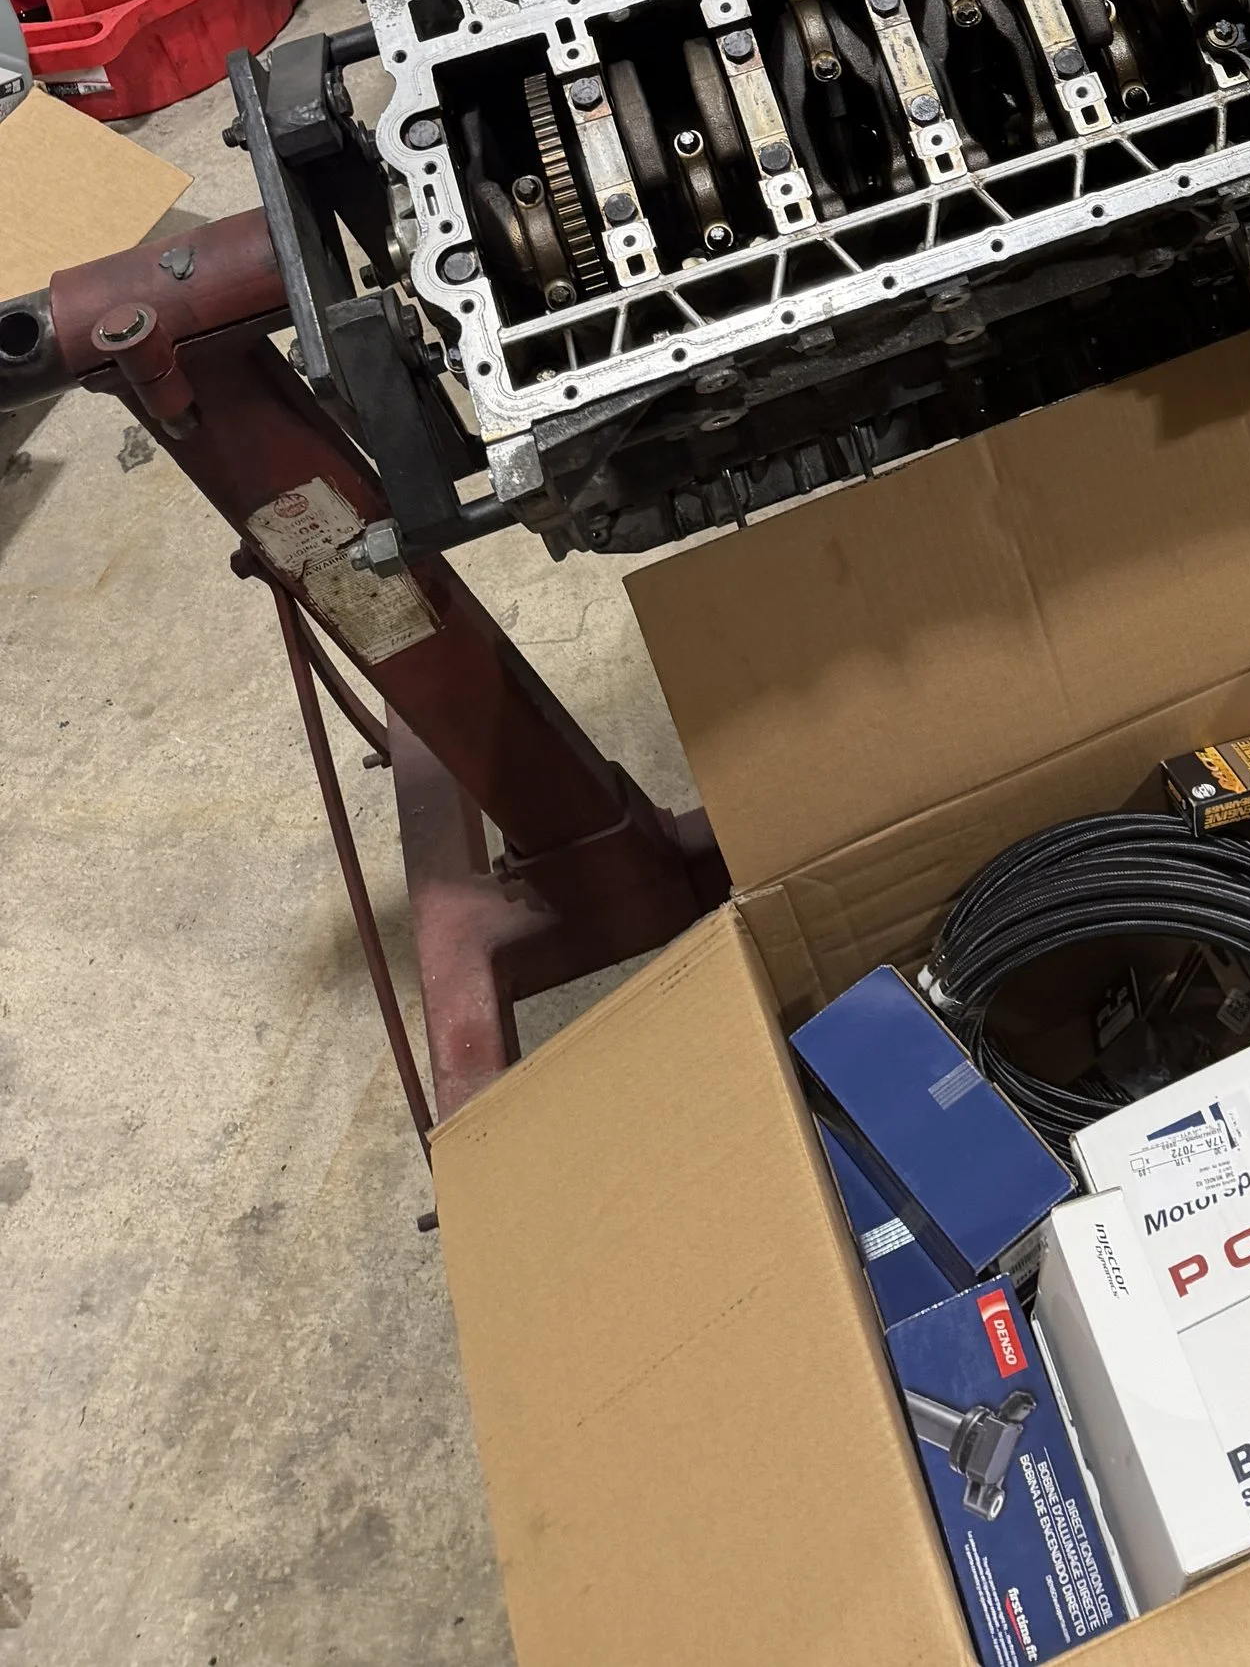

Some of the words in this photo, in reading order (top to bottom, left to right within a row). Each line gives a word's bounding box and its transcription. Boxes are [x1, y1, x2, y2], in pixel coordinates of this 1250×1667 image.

[1095, 1223, 1129, 1296] Injector
[993, 1318, 1018, 1367] DENSO
[1018, 1455, 1042, 1499] BOBINA
[1033, 1499, 1048, 1517] DE
[1035, 1460, 1059, 1505] BOBINE
[1050, 1504, 1085, 1580] D'ALLUMAGE
[1075, 1578, 1101, 1630] DIRECTE
[1038, 1515, 1070, 1585] ENCENDIDO
[1064, 1497, 1087, 1541] DIRECT
[1079, 1540, 1105, 1594] IGNITION
[1096, 1593, 1115, 1623] COIL
[1006, 1586, 1025, 1615] first
[1061, 1584, 1088, 1637] DIRECTO
[1015, 1613, 1035, 1645] time
[1024, 1643, 1040, 1663] fit
